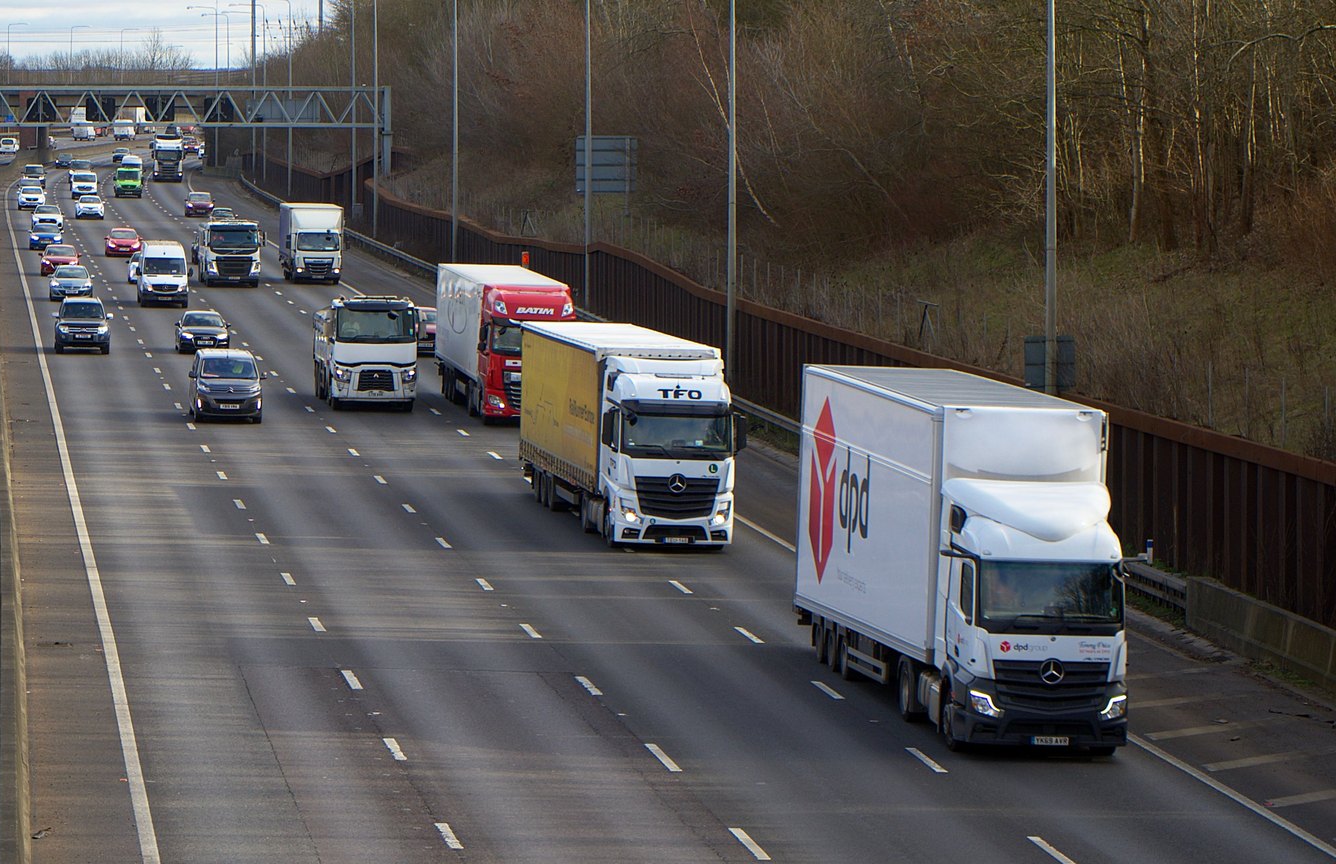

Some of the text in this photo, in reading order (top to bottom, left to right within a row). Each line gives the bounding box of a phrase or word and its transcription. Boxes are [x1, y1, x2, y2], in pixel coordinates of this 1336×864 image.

[515, 306, 555, 315] BATIM
[657, 388, 702, 400] TFO
[839, 446, 871, 554] dpd
